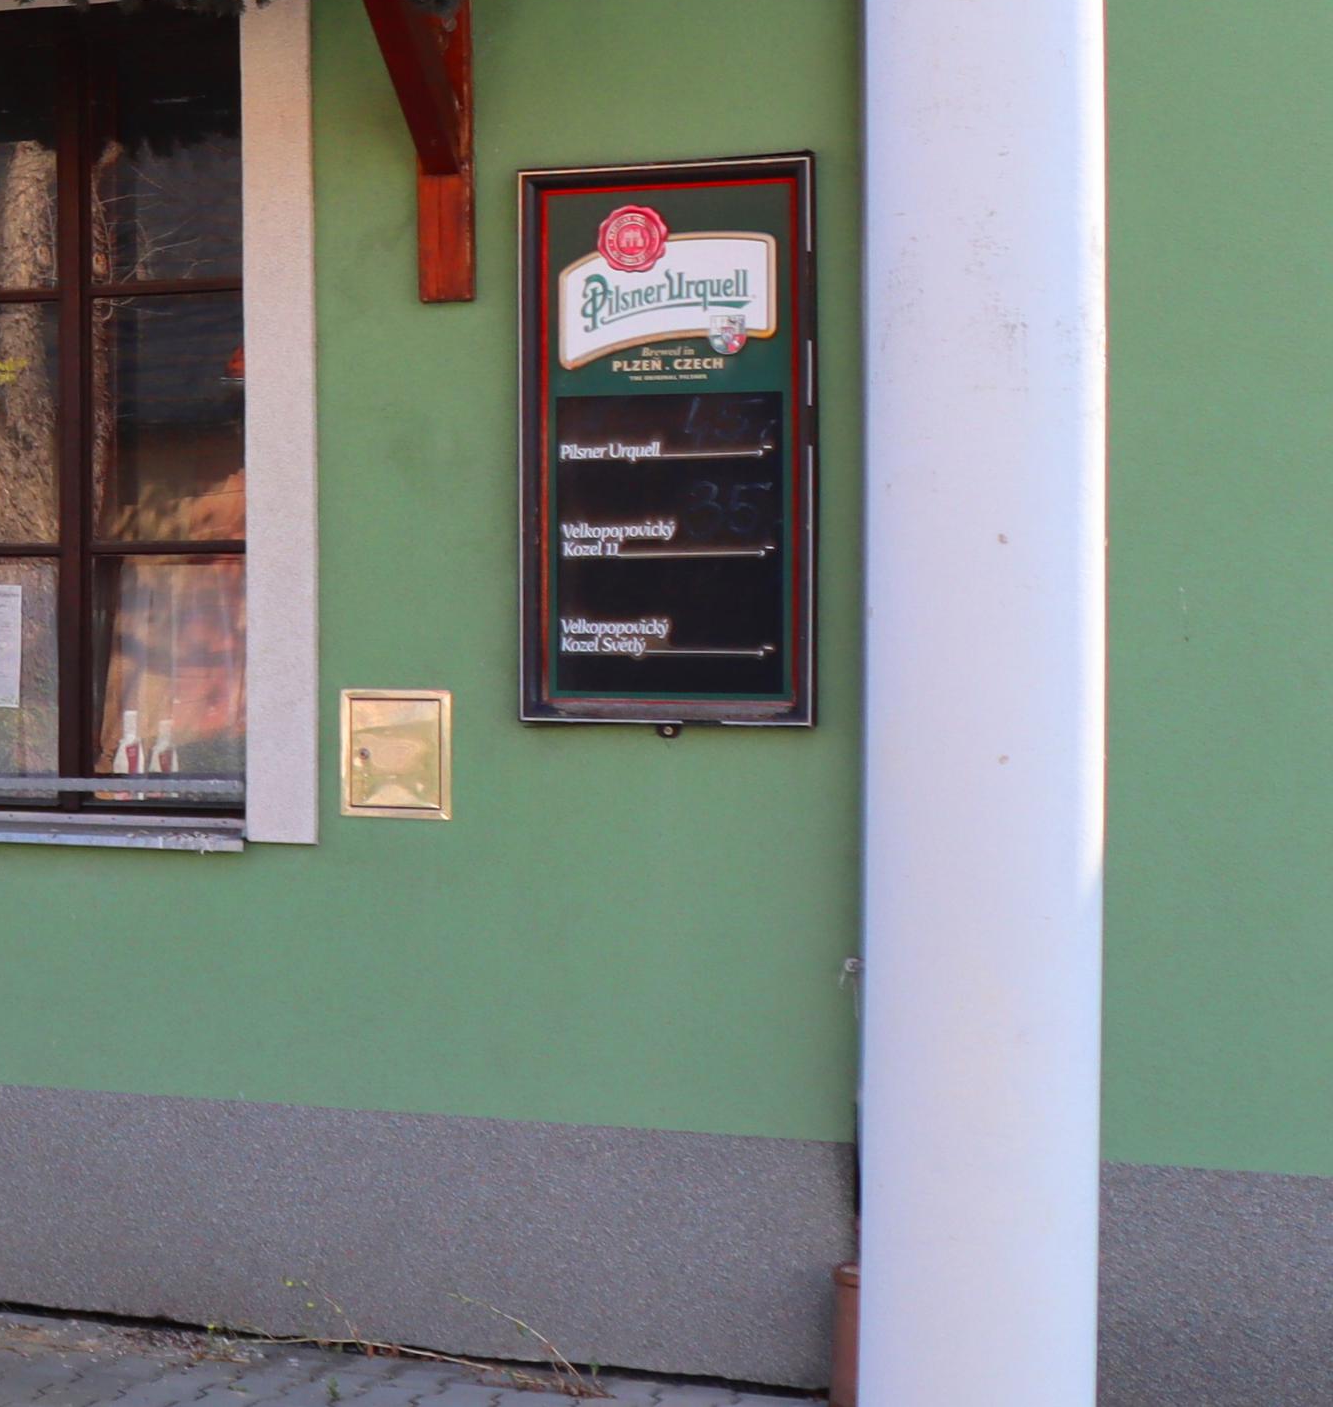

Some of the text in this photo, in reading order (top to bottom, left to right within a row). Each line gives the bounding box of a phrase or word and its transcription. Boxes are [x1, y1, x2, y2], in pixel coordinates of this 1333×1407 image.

[581, 269, 749, 333] Pilsner Urquell
[672, 357, 725, 371] CZECH
[560, 441, 661, 463] Pilsner Urquell
[561, 521, 675, 541] Velkopopovický
[562, 541, 619, 557] Kozel 11
[561, 618, 669, 638] Velkopopovický
[561, 637, 646, 657] Kozel Světlý
